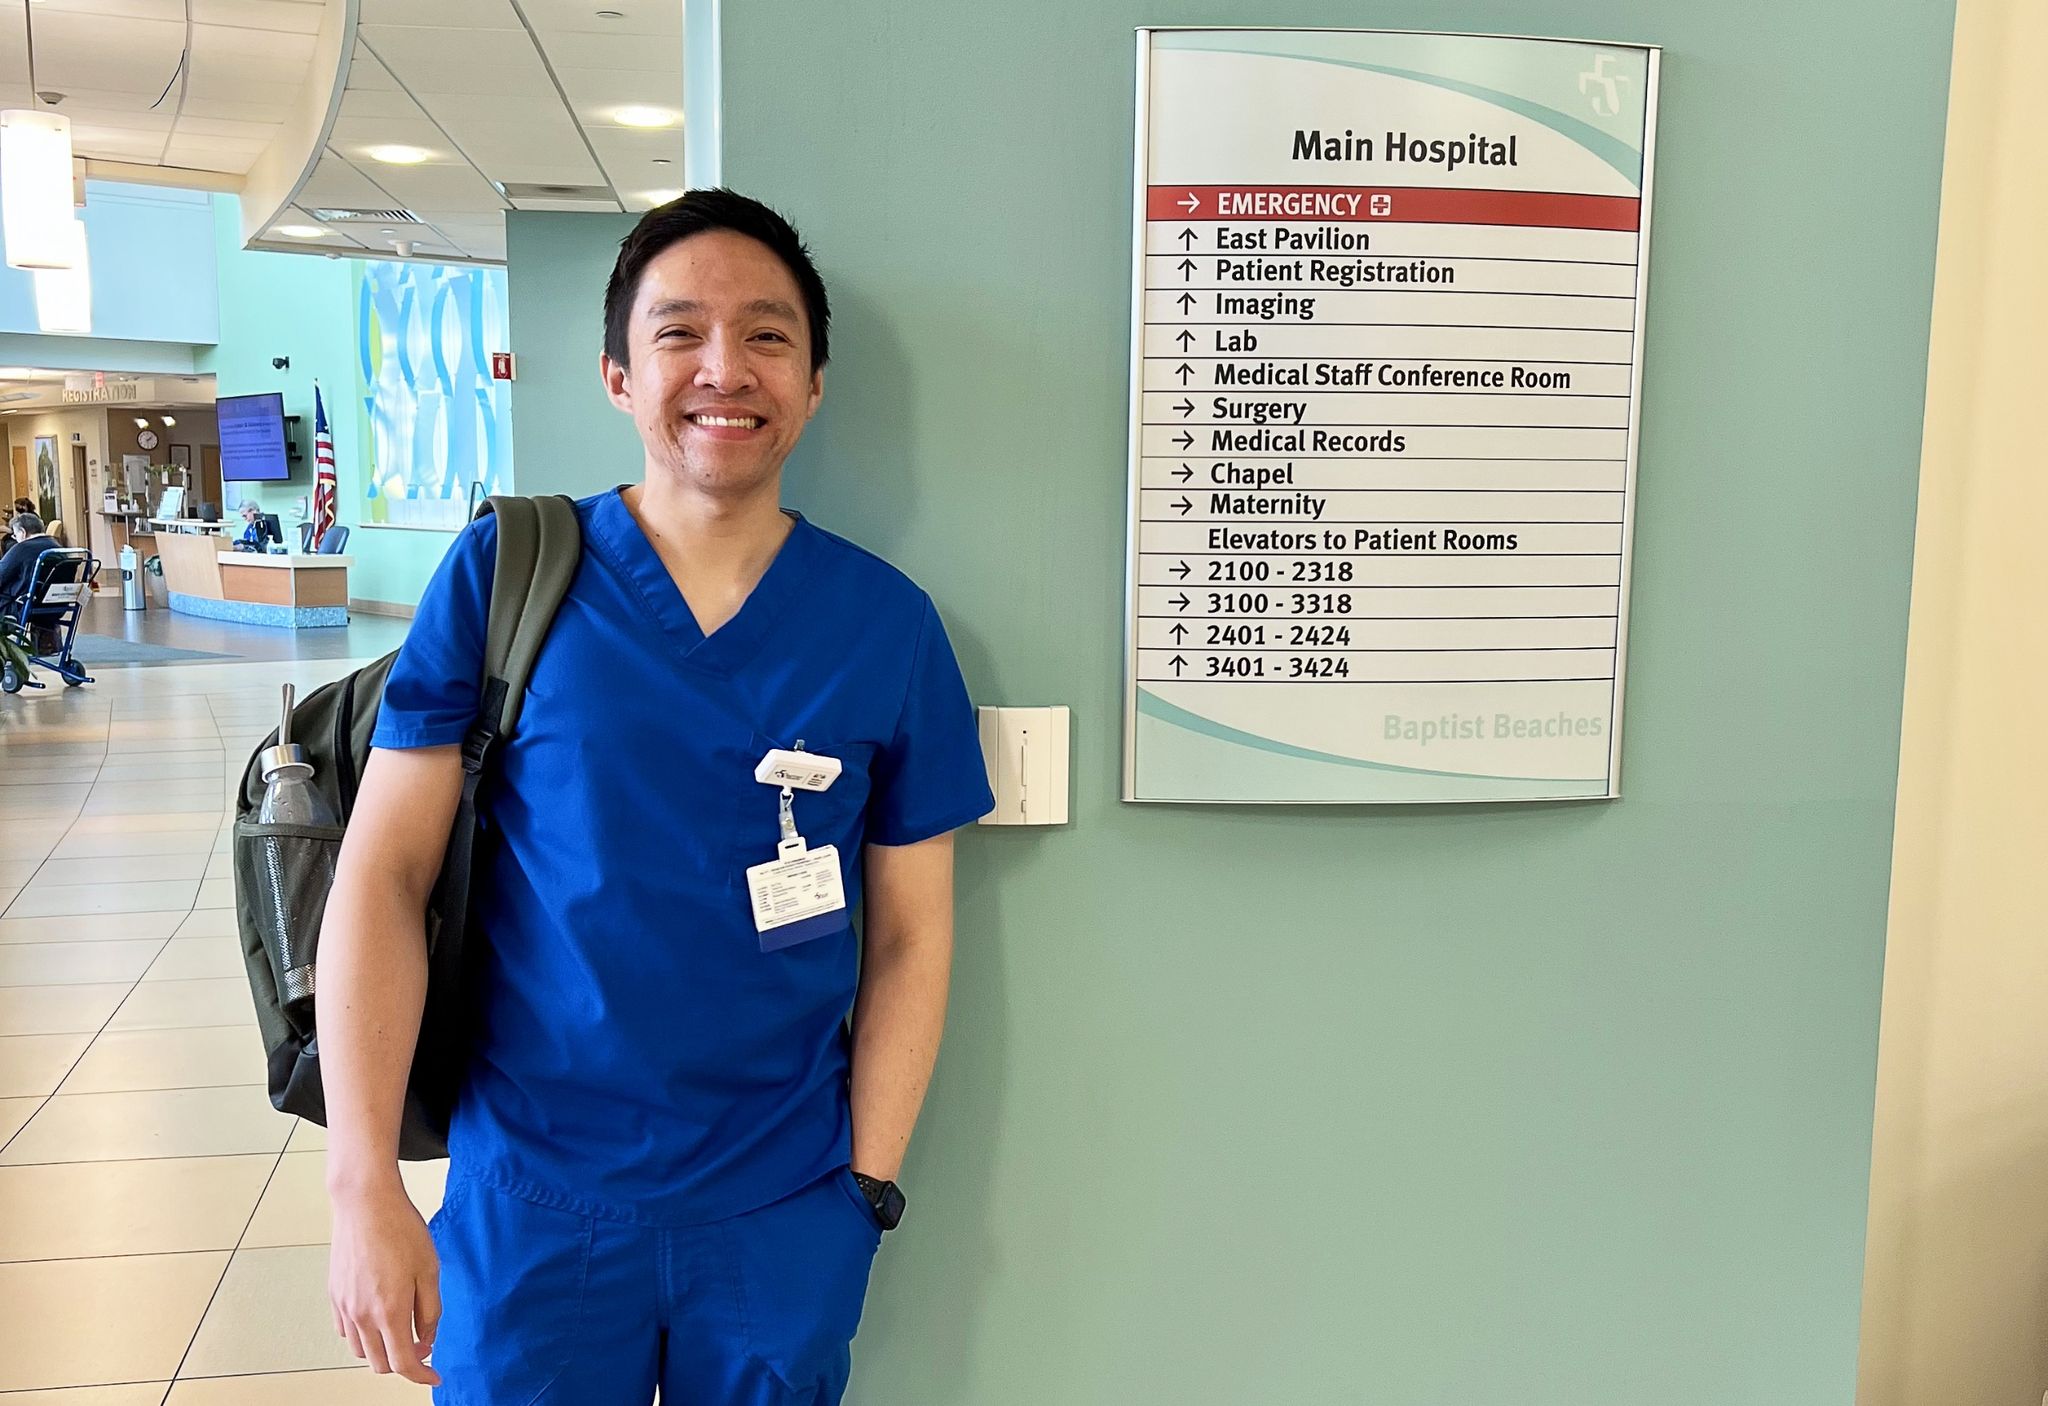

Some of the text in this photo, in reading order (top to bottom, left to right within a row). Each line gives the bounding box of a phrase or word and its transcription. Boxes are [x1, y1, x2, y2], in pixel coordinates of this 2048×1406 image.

[1293, 129, 1518, 172] Main Hospital
[1217, 192, 1362, 217] EMERGENCY
[1217, 226, 1370, 251] East Pavilion
[1216, 259, 1454, 287] Patient Registration
[1216, 291, 1316, 321] Imaging
[1215, 328, 1258, 352] Lab
[1214, 362, 1571, 389] Medical Staff Conference Room
[62, 384, 137, 403] REGISTRATION
[1212, 396, 1307, 426] Surgery
[1211, 429, 1406, 453] Medical Records
[1210, 461, 1294, 490] Chapel
[1210, 492, 1326, 521] Maternity
[1208, 527, 1518, 551] Elevators to Patient Rooms
[1208, 560, 1270, 582] 2100
[1291, 561, 1353, 582] 2318
[1207, 592, 1269, 614] 3100
[1291, 593, 1352, 614] 3318
[1206, 624, 1266, 646] 2401
[1290, 625, 1351, 646] 2424
[1205, 656, 1265, 678] 3401
[1289, 657, 1349, 678] 3424
[1384, 711, 1602, 746] Baptist Beaches
